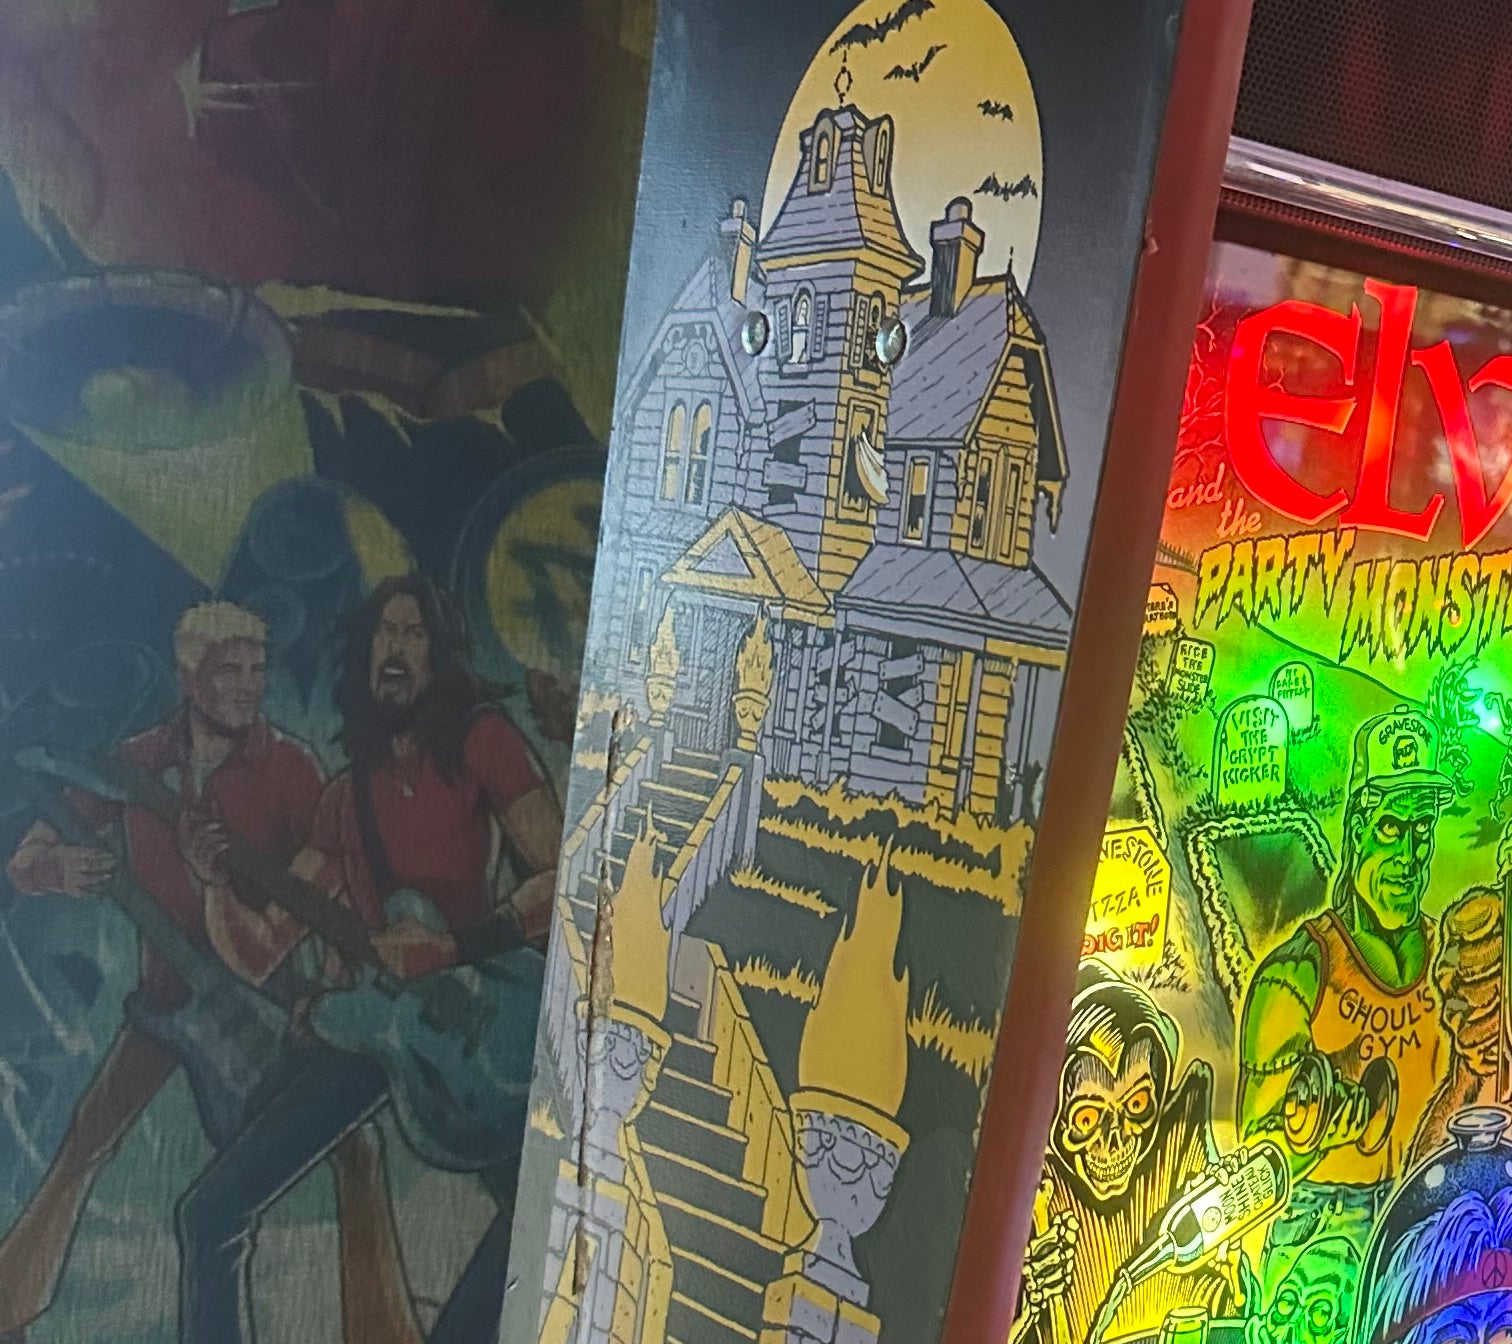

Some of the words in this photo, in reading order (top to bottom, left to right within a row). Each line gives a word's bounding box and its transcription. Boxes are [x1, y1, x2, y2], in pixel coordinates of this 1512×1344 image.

[1166, 462, 1225, 509] and
[1216, 498, 1263, 538] the
[1192, 526, 1358, 632] PARTY
[1126, 913, 1160, 948] IT!
[1339, 985, 1436, 1033] GHOUL'S
[1359, 1030, 1422, 1060] GYM
[1219, 1188, 1238, 1225] MOON
[1231, 1174, 1251, 1221] SHINE
